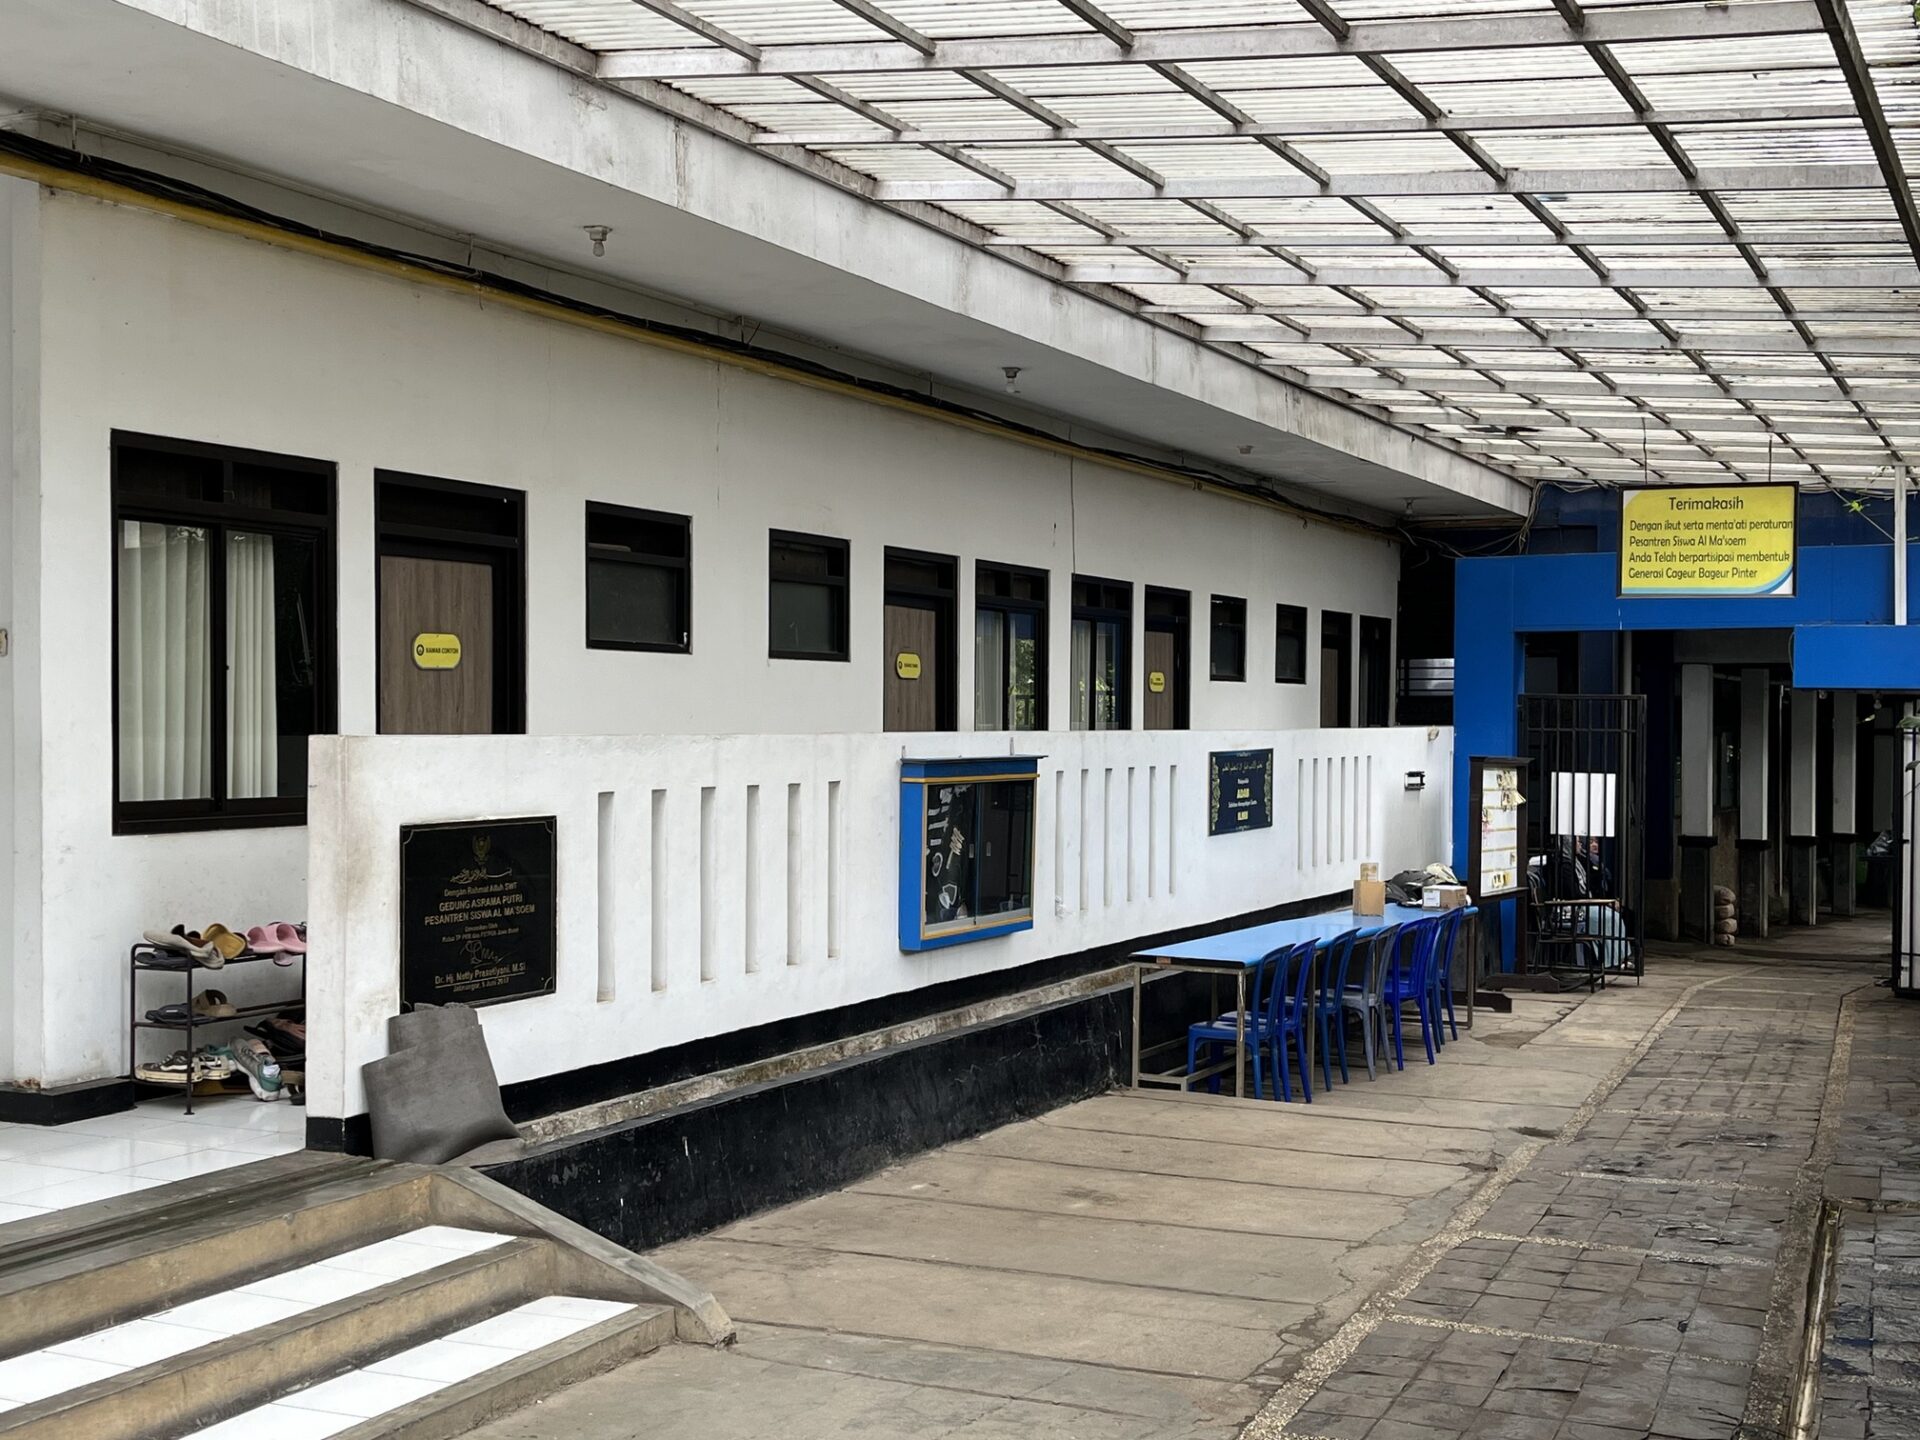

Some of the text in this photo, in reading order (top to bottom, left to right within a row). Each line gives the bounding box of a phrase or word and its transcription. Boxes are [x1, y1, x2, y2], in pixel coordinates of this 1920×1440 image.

[1669, 496, 1744, 510] Terimakasih
[1630, 520, 1793, 532] Dengan ikut serta menta'ati peraturan
[1630, 536, 1746, 546] Pesantren Siswa Al Ma'soem
[1629, 551, 1790, 564] Anda Telah berpartisipasi membentuk
[1628, 567, 1758, 580] Generasi Cageur Bageur Pinter
[439, 894, 523, 912] GEDUNG ASRAMA PUTRI
[424, 904, 535, 926] PESANTREN SISWA AL MA'SOEM
